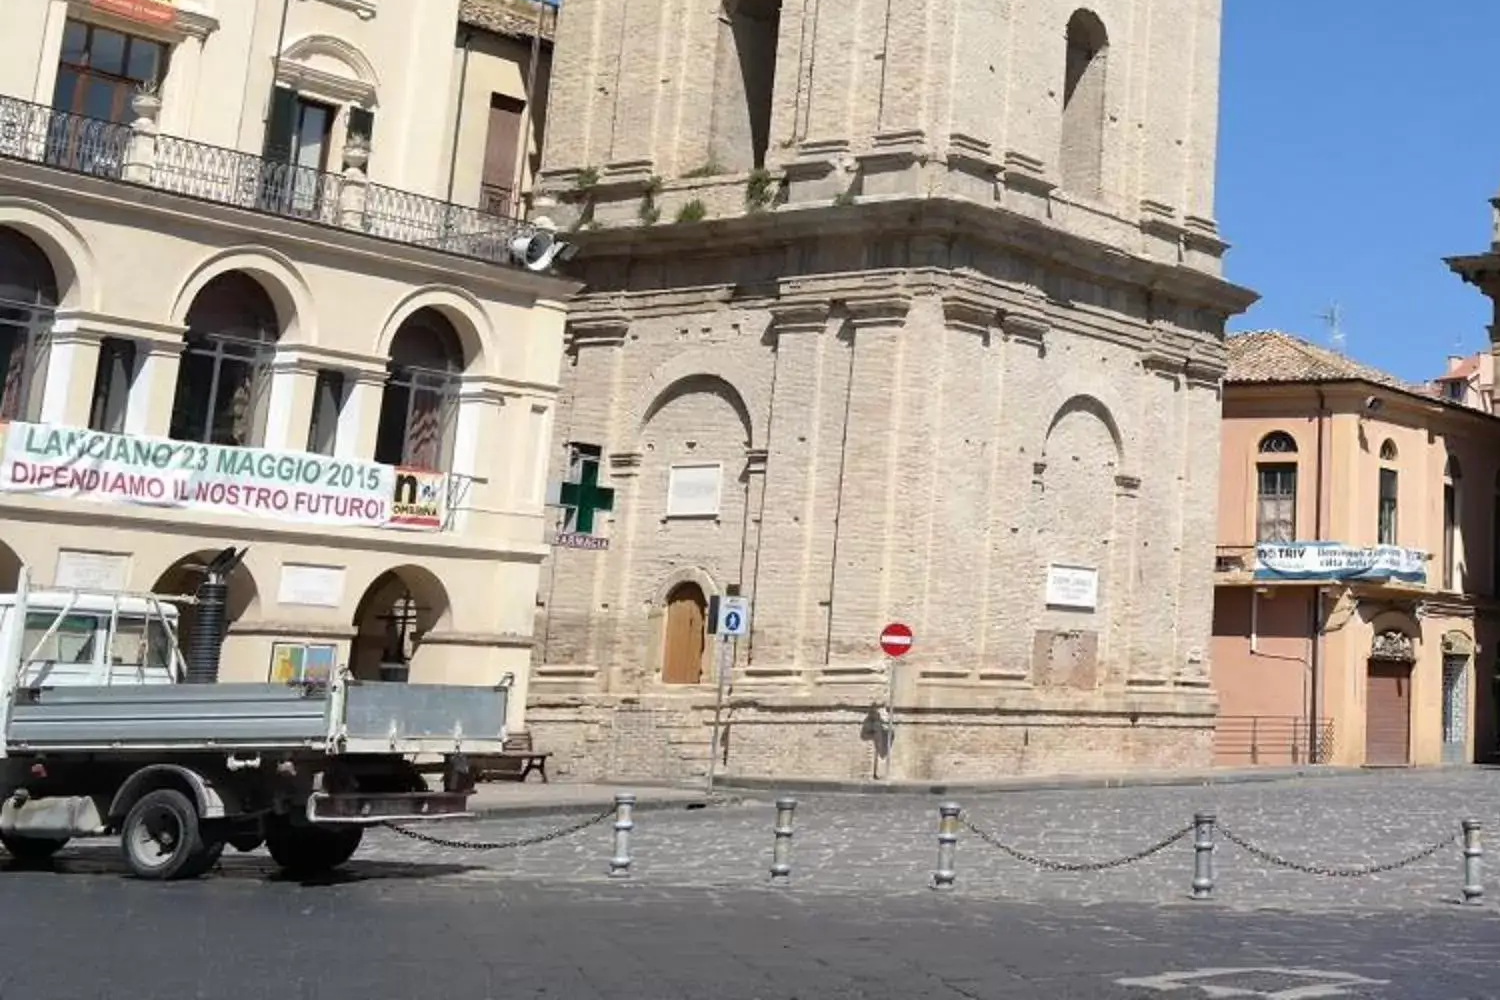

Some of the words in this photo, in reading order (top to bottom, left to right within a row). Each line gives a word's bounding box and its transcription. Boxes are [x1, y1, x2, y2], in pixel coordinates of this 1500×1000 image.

[25, 427, 174, 469] LANCIANO
[182, 446, 209, 472] 23
[216, 449, 321, 484] MAGGIO
[327, 463, 381, 490] 2015
[11, 460, 165, 498] DIFENDIAMO
[173, 479, 189, 501] IL
[195, 481, 289, 510] NOSTRO
[295, 491, 386, 520] FUTURO!
[1278, 547, 1307, 559] TRIV
